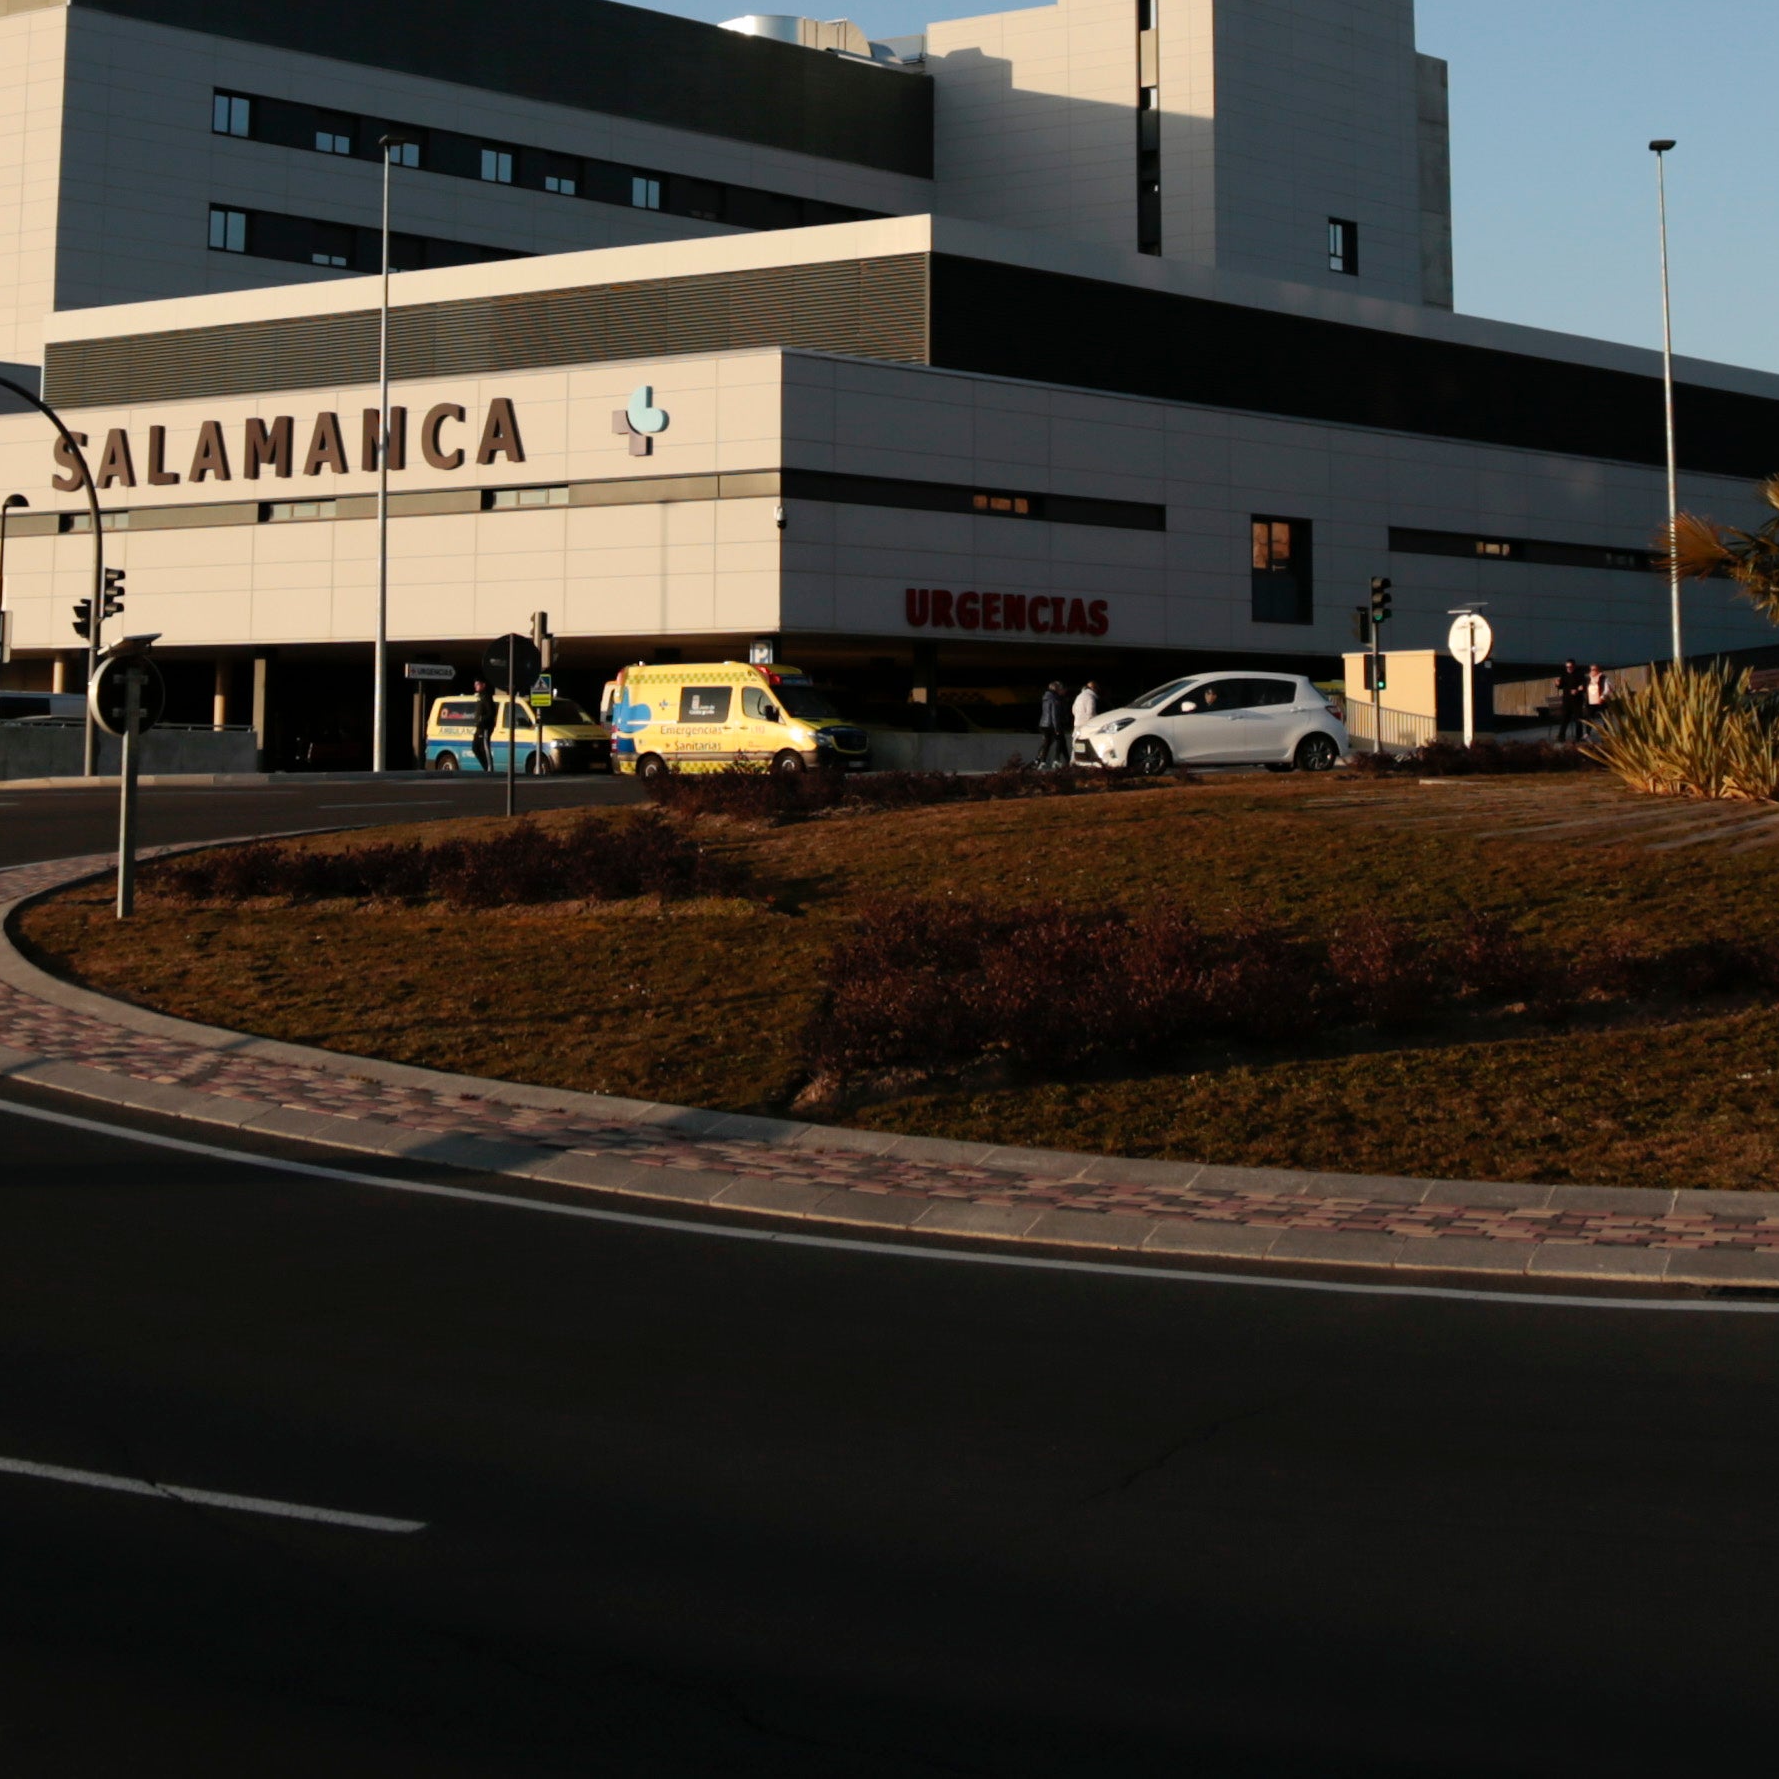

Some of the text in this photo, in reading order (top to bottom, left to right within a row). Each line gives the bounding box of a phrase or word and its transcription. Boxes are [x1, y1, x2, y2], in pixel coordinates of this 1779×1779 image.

[51, 397, 526, 492] SALAMANCA
[905, 588, 1109, 636] URGENCIAS
[660, 726, 722, 736] Emergencias
[674, 741, 722, 751] Sanitarias
